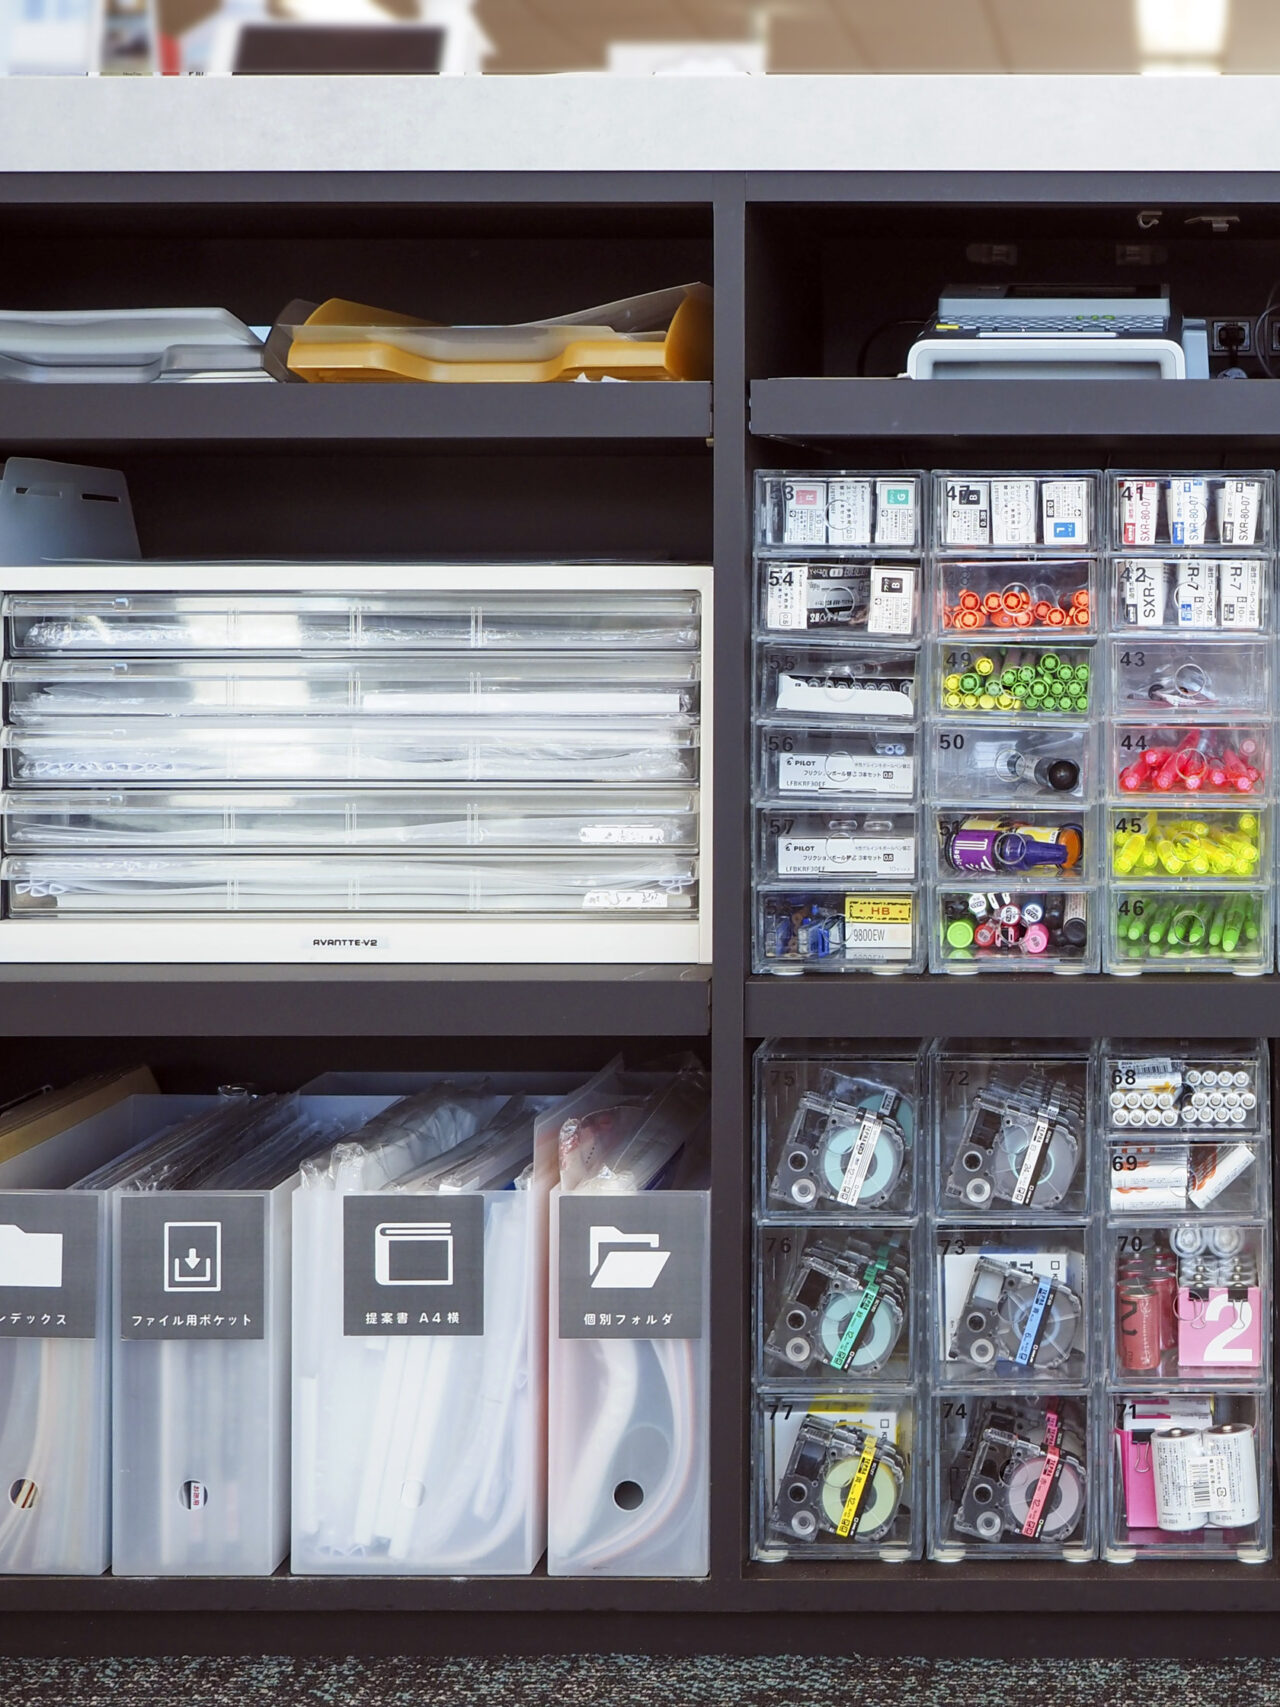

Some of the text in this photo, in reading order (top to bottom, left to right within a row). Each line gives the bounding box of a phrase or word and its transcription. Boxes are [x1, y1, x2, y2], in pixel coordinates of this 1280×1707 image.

[771, 485, 794, 501] 53
[897, 493, 906, 501] G
[946, 485, 970, 501] 47
[1121, 486, 1144, 501] 41
[1140, 496, 1151, 541] SXR-80-07
[1189, 495, 1199, 541] SXR-80-07
[1239, 495, 1250, 541] SXR-80-07
[769, 571, 793, 586] 54
[1121, 567, 1146, 582] 42
[891, 581, 901, 589] B
[1143, 575, 1156, 618] SXR-7
[769, 653, 795, 670] 55
[946, 651, 972, 667] 49
[1121, 651, 1146, 667] 43
[769, 736, 794, 751] 56
[940, 734, 965, 750] 50
[1121, 735, 1146, 751] 44
[770, 819, 794, 834] 57
[940, 821, 959, 836] 51
[1116, 817, 1142, 833] 45
[871, 907, 891, 915] HB
[1118, 900, 1144, 916] 46
[312, 938, 378, 947] AVANTTE-V2
[853, 929, 885, 942] 9800EW
[770, 1070, 794, 1086] 75
[944, 1070, 969, 1086] 72
[1112, 1069, 1136, 1085] 68
[884, 1095, 893, 1110] TEPRA
[862, 1125, 871, 1142] TEPRA
[1036, 1126, 1046, 1143] TEPRA
[1112, 1155, 1137, 1171] 69
[766, 1237, 791, 1253] 76
[940, 1239, 966, 1255] 73
[1117, 1236, 1143, 1252] 70
[862, 1294, 874, 1310] TEPRA
[1037, 1289, 1048, 1306] TEPRA
[131, 1313, 252, 1327] ファイル用ポケット
[365, 1311, 461, 1326] 提案書 A4 横
[583, 1312, 673, 1327] 個別フォルダ
[1203, 1293, 1253, 1362] 2
[768, 1404, 793, 1420] 77
[943, 1403, 967, 1419] 74
[1116, 1403, 1137, 1420] 71
[861, 1458, 870, 1475] TEPRA
[1046, 1460, 1056, 1477] TEPRA
